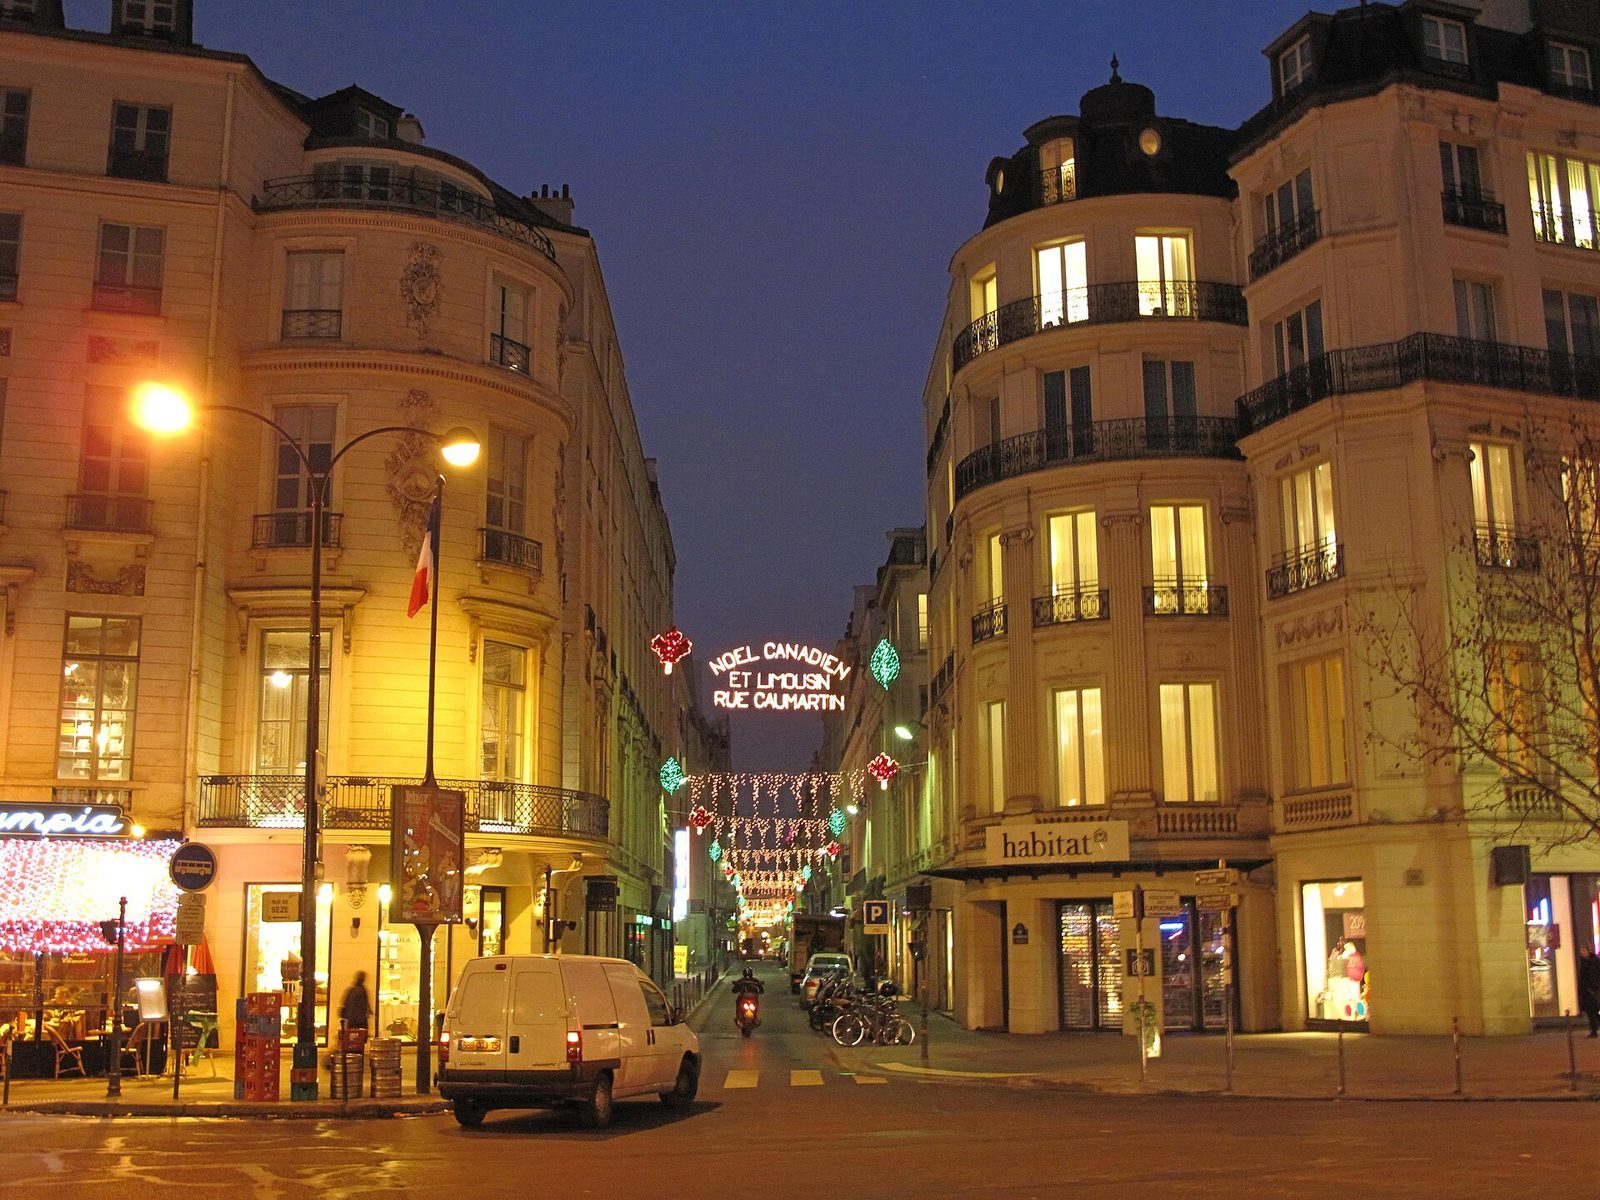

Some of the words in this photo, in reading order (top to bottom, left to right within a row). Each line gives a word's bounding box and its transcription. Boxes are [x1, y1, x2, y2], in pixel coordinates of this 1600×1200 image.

[709, 646, 760, 676] NOEL
[763, 642, 851, 680] CANADIEN
[729, 671, 752, 688] ET
[757, 672, 831, 690] LIMOUSIN
[714, 690, 749, 708] RUE
[753, 692, 845, 711] CAUMARTIN
[1003, 831, 1092, 858] habitat
[871, 906, 883, 921] P
